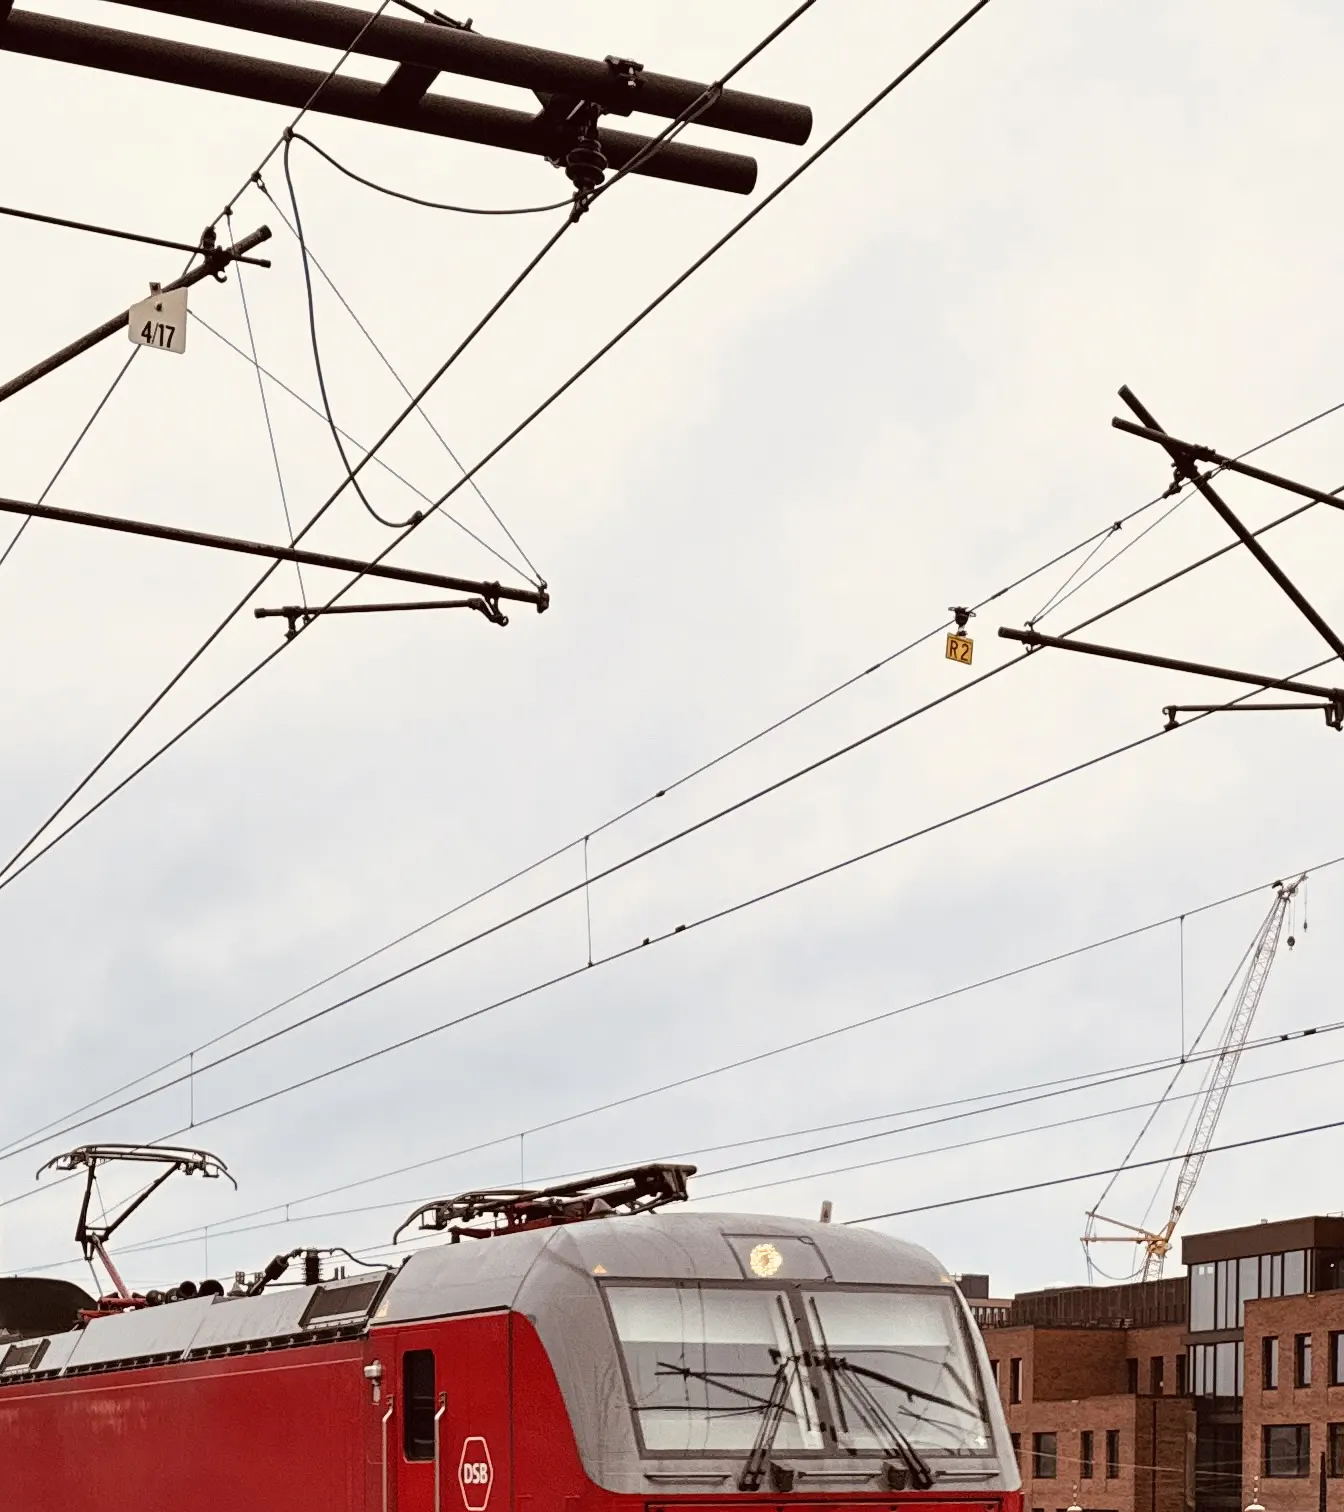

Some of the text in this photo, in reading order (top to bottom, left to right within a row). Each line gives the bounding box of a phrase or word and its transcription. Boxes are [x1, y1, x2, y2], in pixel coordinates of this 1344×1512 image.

[140, 320, 176, 349] 4/17
[949, 639, 969, 662] R2
[463, 1462, 488, 1484] DSB
